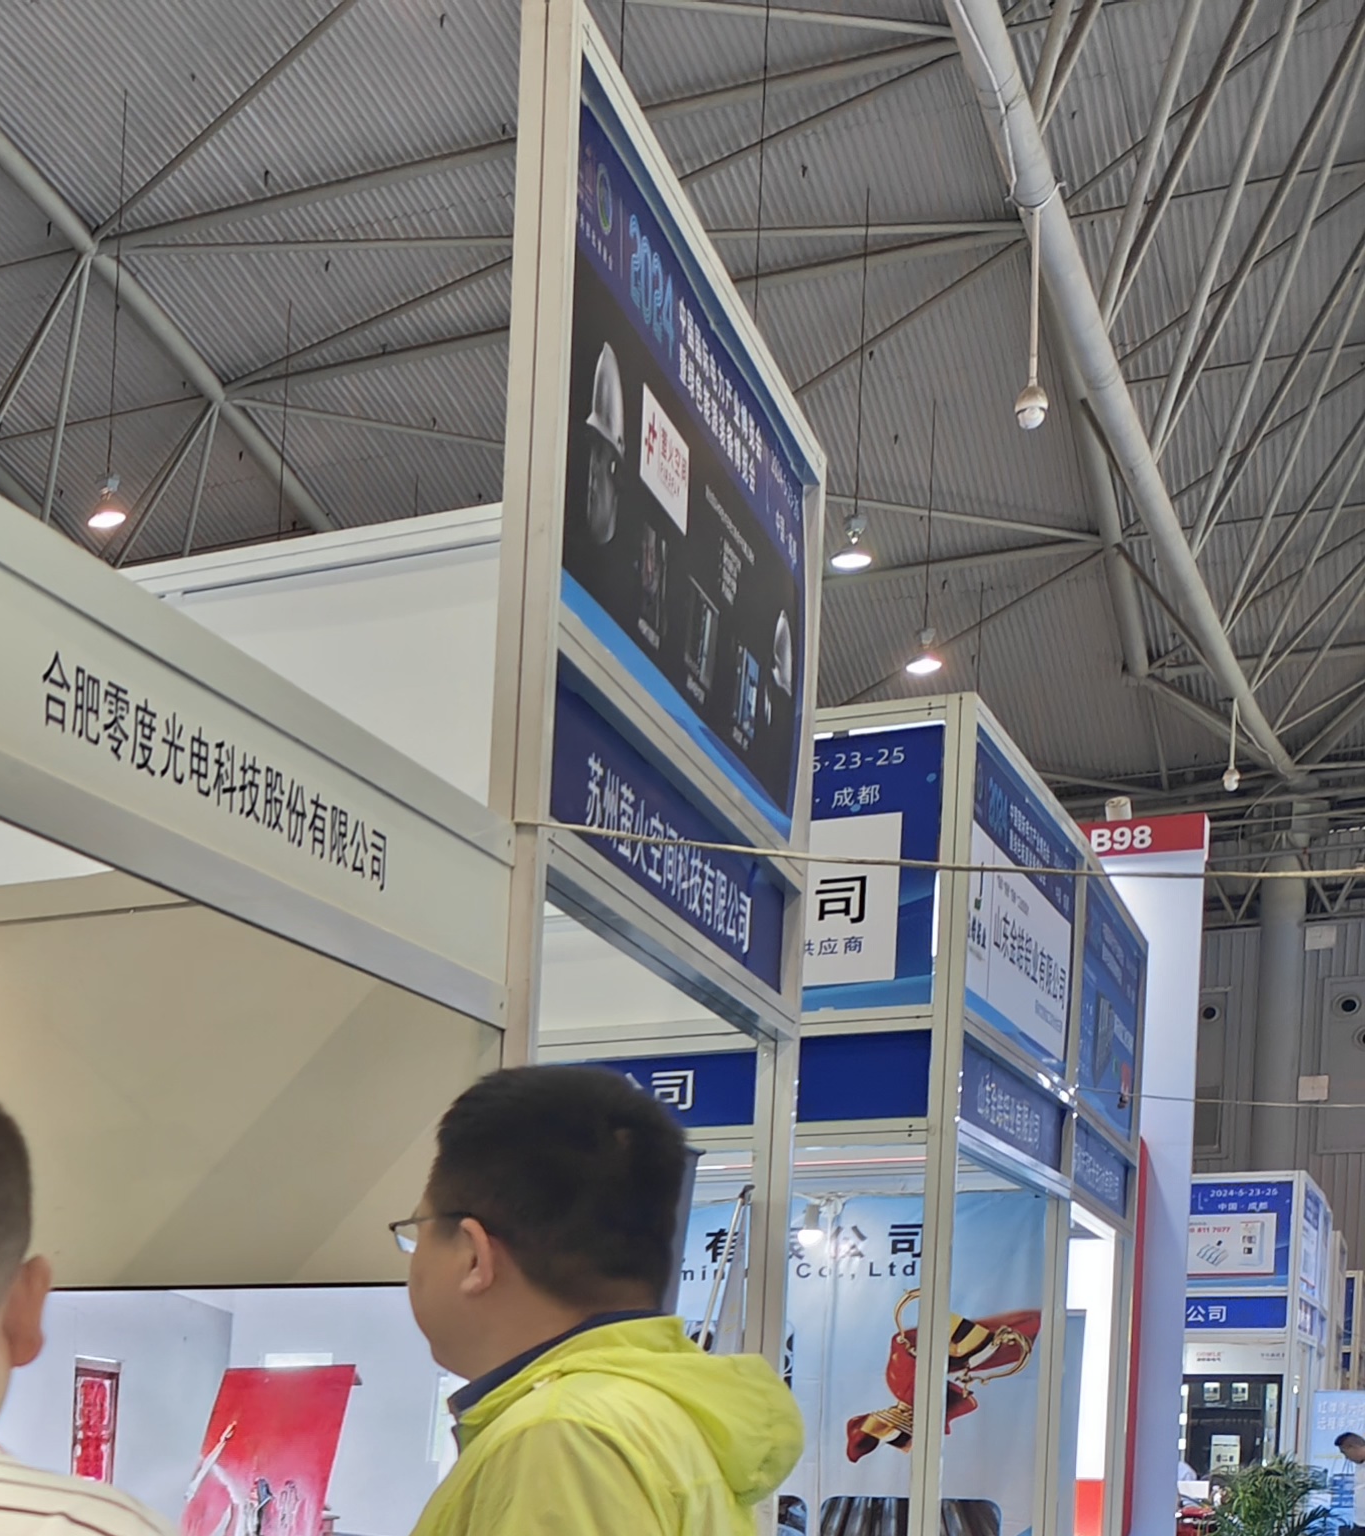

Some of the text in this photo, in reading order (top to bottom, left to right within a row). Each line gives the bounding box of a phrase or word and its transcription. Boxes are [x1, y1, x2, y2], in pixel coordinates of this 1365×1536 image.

[629, 214, 674, 358] 2024
[42, 650, 387, 892] 合肥零度光电科技股份有限公司
[831, 784, 881, 809] 成都
[1090, 825, 1152, 853] B98
[815, 875, 867, 924] 司
[868, 1261, 916, 1277] Ltd
[1186, 1305, 1227, 1323] 公司
